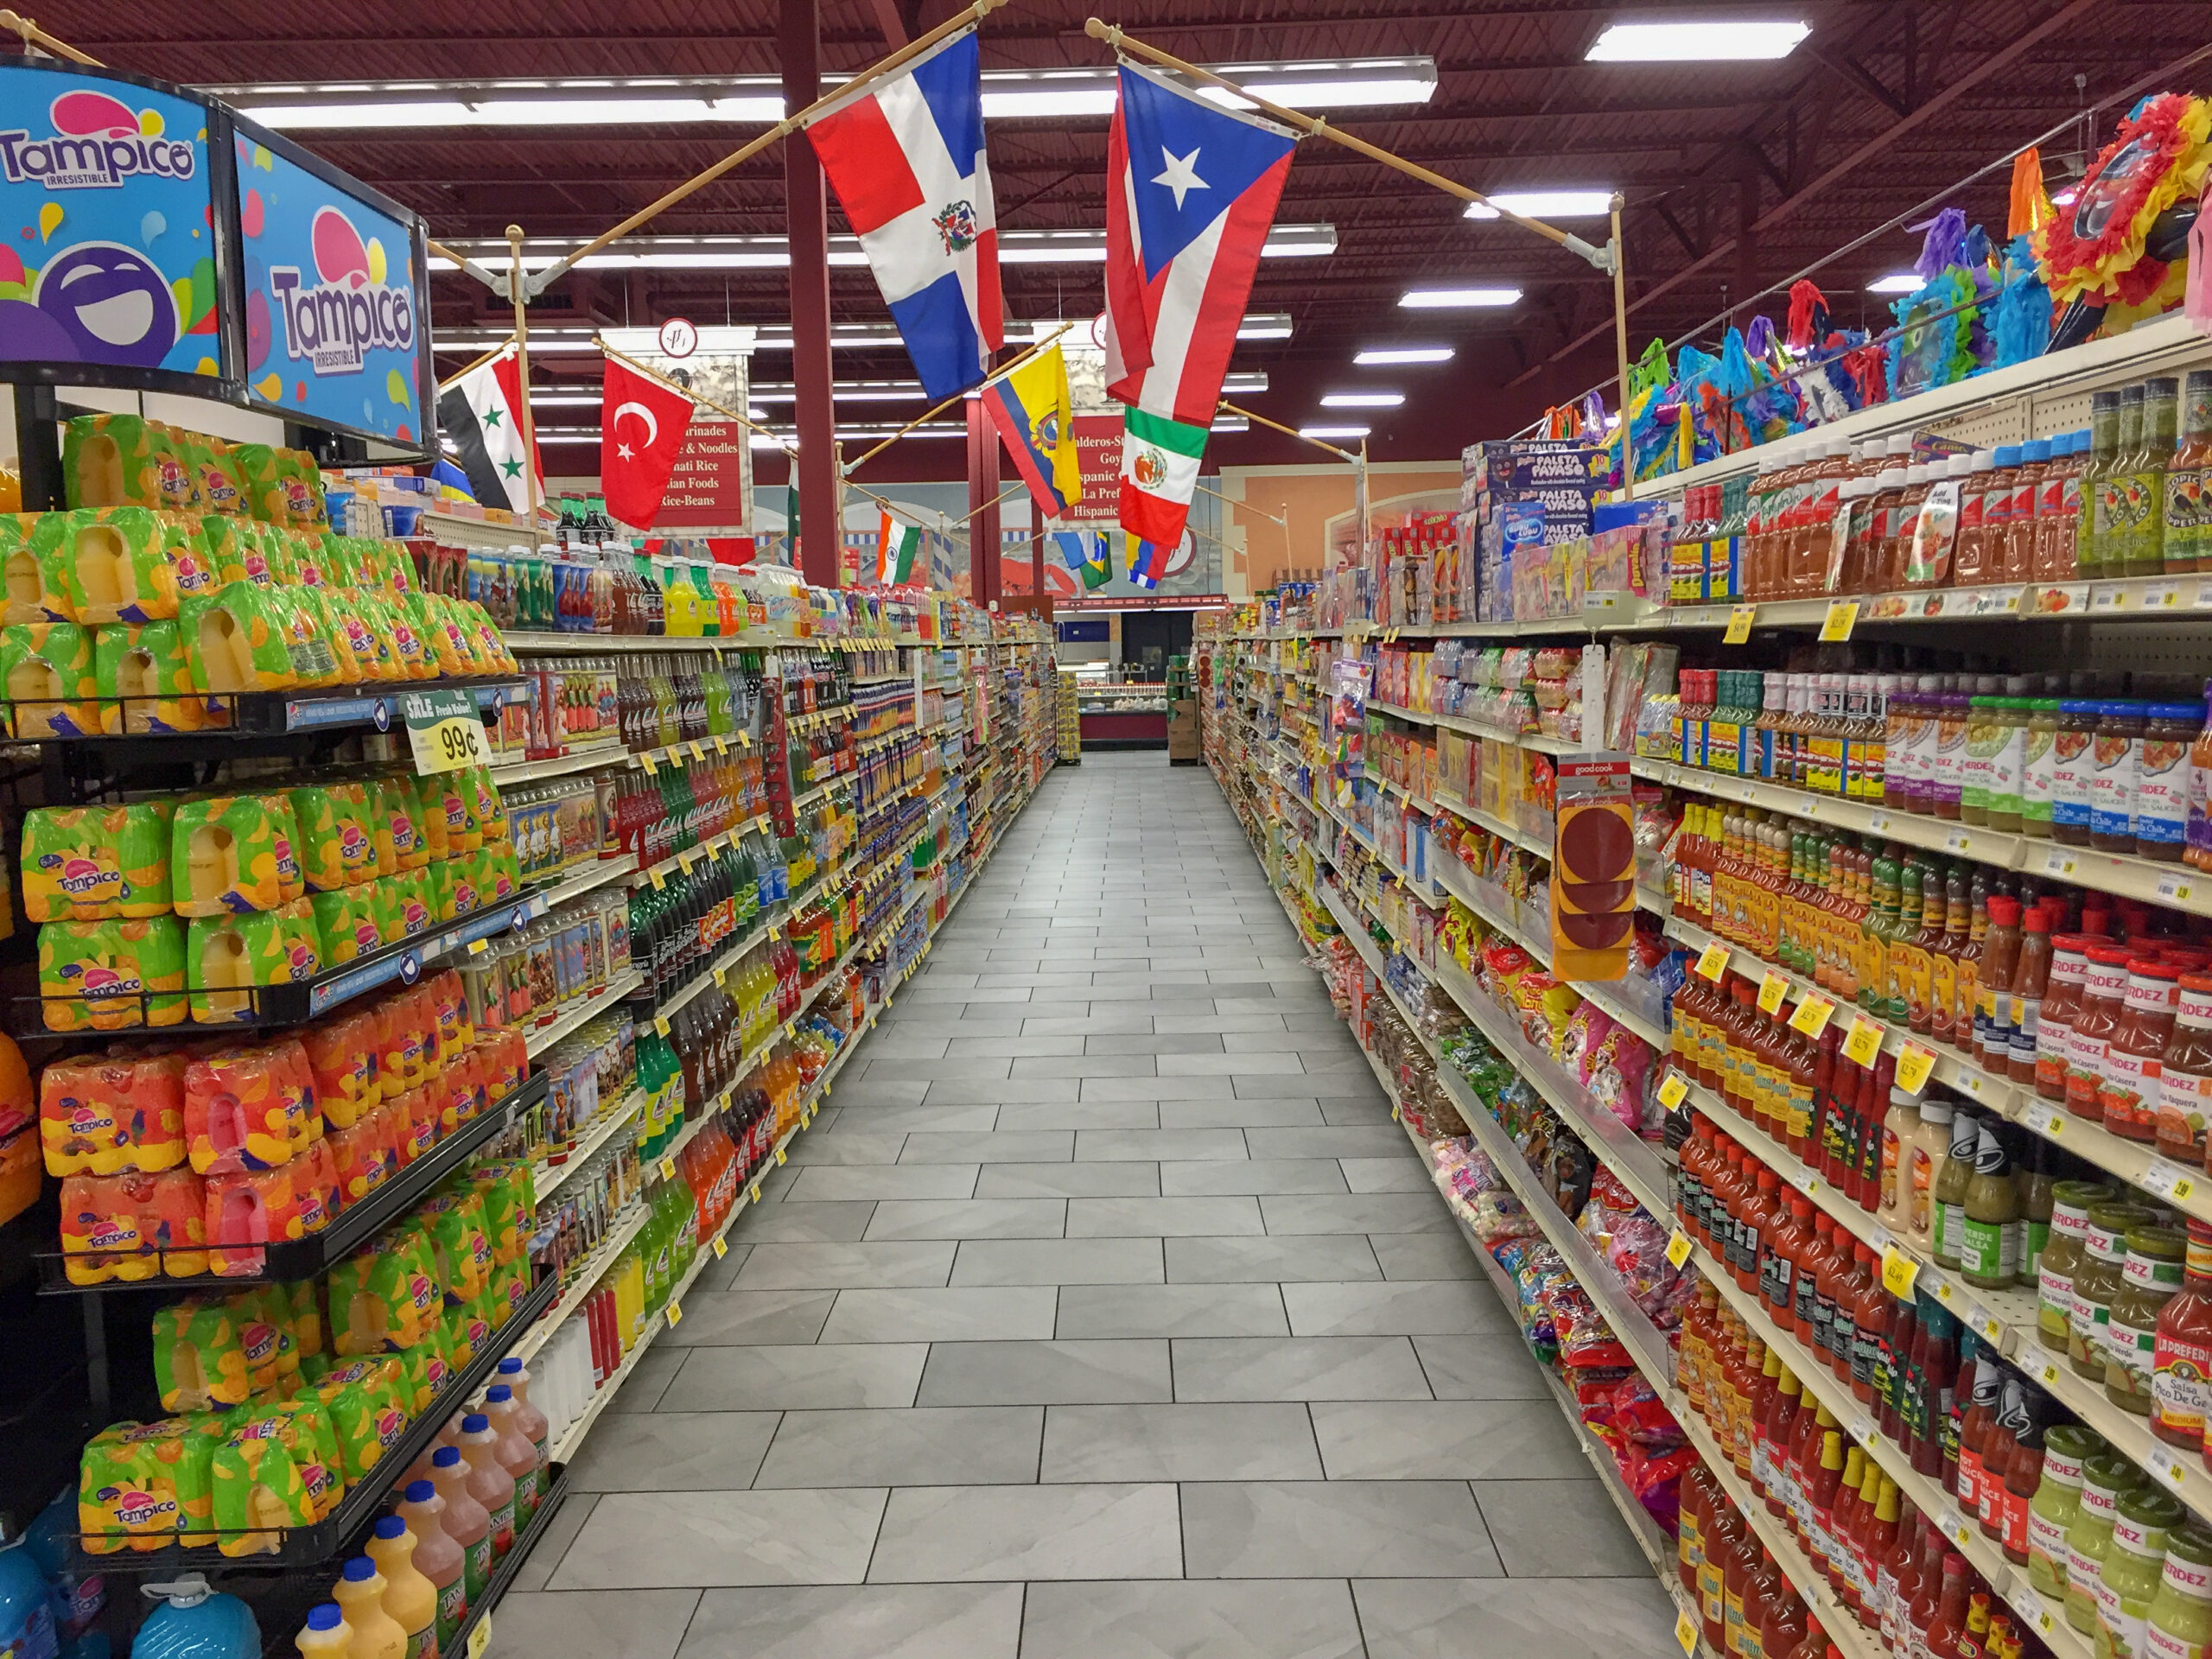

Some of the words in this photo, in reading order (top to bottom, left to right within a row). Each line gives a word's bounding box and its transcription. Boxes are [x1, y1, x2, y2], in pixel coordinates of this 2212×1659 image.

[1, 132, 193, 183] Tampico
[47, 173, 109, 185] IRRESISTIBLE
[273, 272, 411, 365] Tampico
[315, 350, 354, 367] IRRESISTIBLE
[685, 425, 727, 436] rinades
[697, 442, 738, 454] Noodles
[696, 460, 719, 471] Rice
[1100, 453, 1122, 467] Goy
[1536, 454, 1580, 466] PALETA
[1595, 454, 1605, 465] 10
[1079, 471, 1116, 484] spanic
[1531, 464, 1585, 478] PAYASO
[689, 477, 719, 488] Foods
[1083, 488, 1096, 499] La
[1539, 489, 1583, 501] PALETA
[1598, 489, 1607, 500] 10
[1074, 505, 1119, 519] Hispanic
[406, 697, 435, 719] SALE
[435, 702, 454, 717] Fresh
[451, 701, 473, 715] Value!
[442, 724, 479, 764] 99¢
[1575, 763, 1595, 776] good
[1595, 762, 1614, 772] cook
[57, 870, 120, 893] Tampico
[2051, 959, 2088, 976] ERDEZ
[2088, 973, 2125, 989] ERDEZ
[2126, 985, 2164, 1002] ERDEZ
[2177, 1001, 2212, 1019] ERDEZ
[2038, 1025, 2066, 1039] ERDEZ
[2071, 1039, 2101, 1056] ERDEZ
[2077, 1058, 2100, 1071] Casera
[2114, 1075, 2137, 1088] Casera
[2162, 1074, 2196, 1091] ERDEZ
[2168, 1095, 2198, 1109] Taquera
[68, 1117, 113, 1134] Tampico
[2052, 1212, 2089, 1231] ERDEZ
[88, 1230, 137, 1248] Tampico
[2158, 1338, 2168, 1352] LA
[2167, 1340, 2210, 1363] PREFERI
[2170, 1378, 2198, 1395] Salsa
[2173, 1387, 2190, 1403] De
[2164, 1414, 2202, 1426] MEDIUM
[2045, 1457, 2082, 1478] ERDEZ
[2082, 1488, 2116, 1510] ERDE
[114, 1500, 177, 1526] Tampico
[2164, 1559, 2208, 1588] ERDEZ
